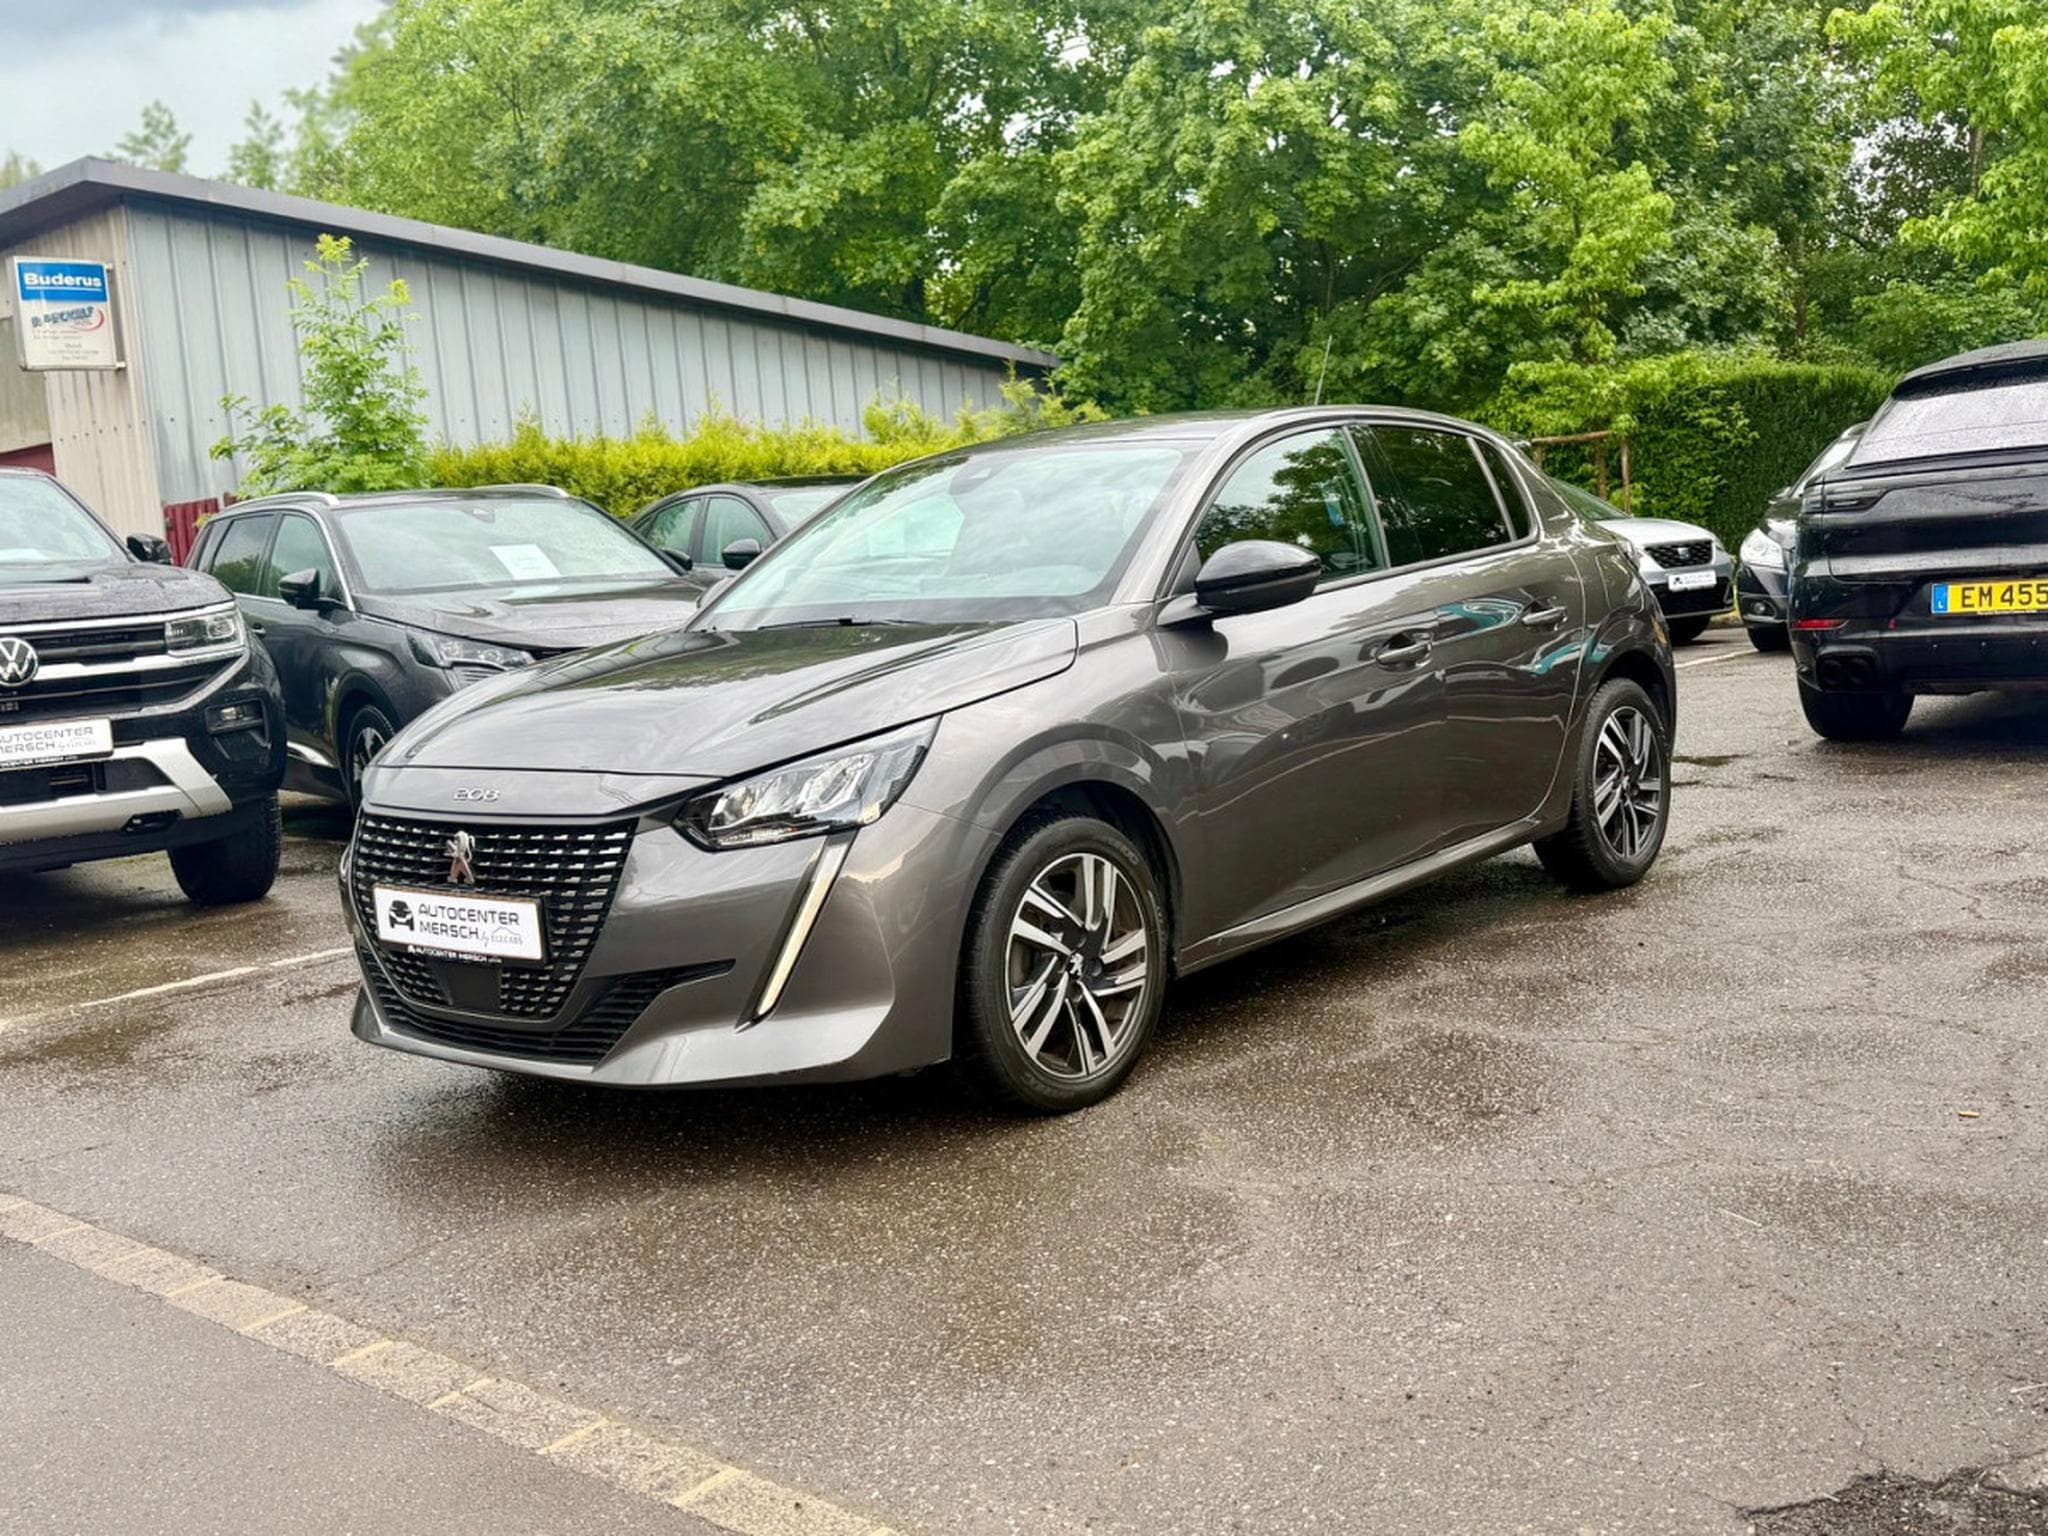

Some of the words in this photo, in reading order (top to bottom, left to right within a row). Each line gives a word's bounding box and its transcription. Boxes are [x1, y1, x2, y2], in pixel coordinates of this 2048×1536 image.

[23, 272, 102, 287] Buderus
[1961, 586, 1993, 608] EM
[1999, 583, 2048, 606] 455
[0, 726, 94, 744] UTOCENTER
[453, 787, 500, 802] 208
[418, 903, 520, 926] AUTOCENTER
[419, 921, 480, 940] MERSCH
